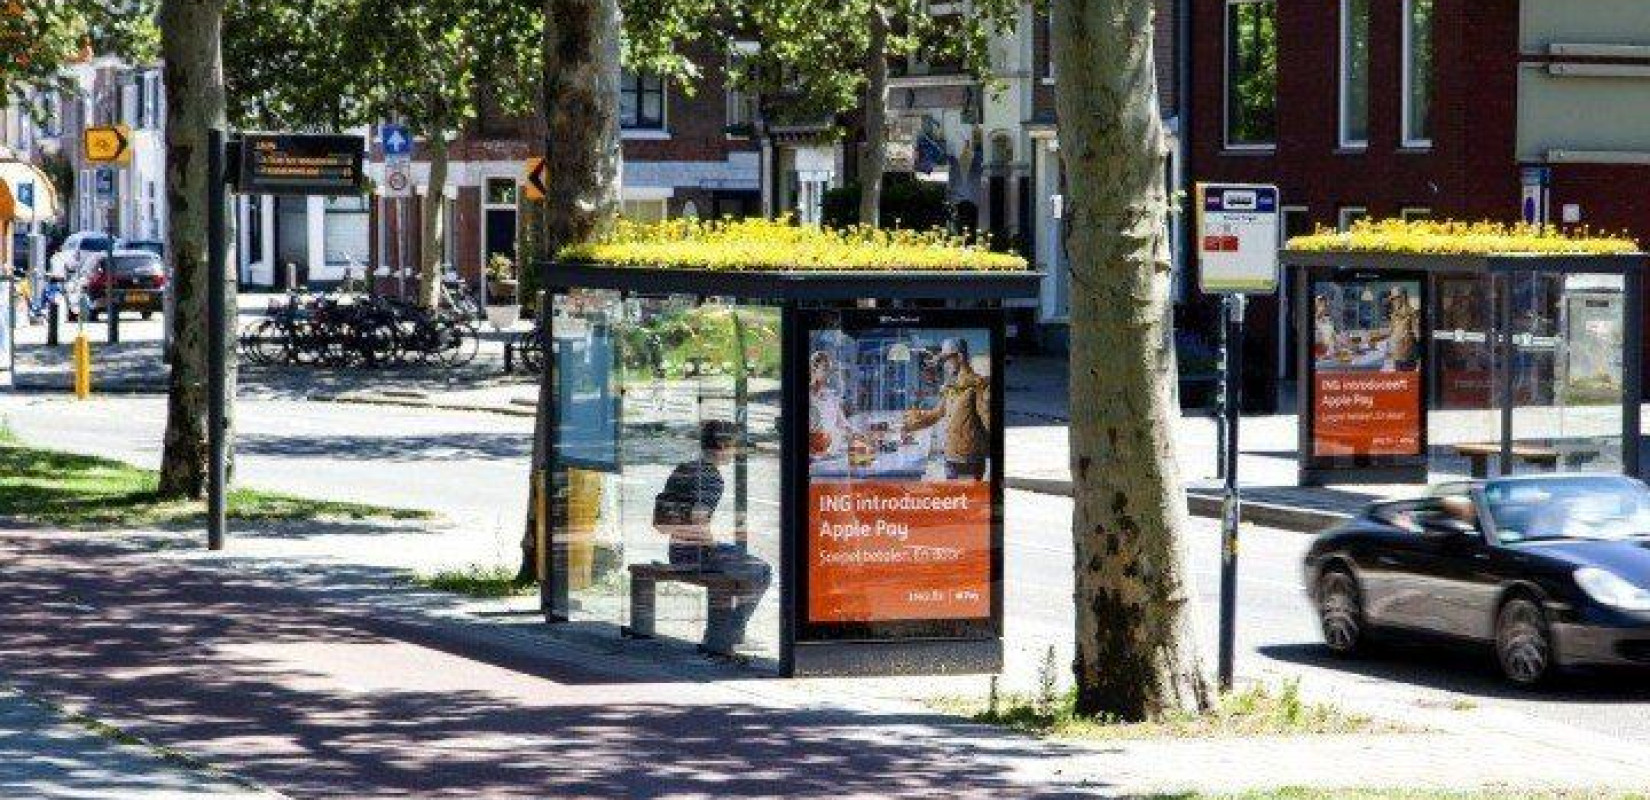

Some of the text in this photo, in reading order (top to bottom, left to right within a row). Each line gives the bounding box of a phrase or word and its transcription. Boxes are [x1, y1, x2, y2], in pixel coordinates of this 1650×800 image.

[819, 493, 968, 512] ING introduceert
[819, 518, 909, 542] Apple Pay
